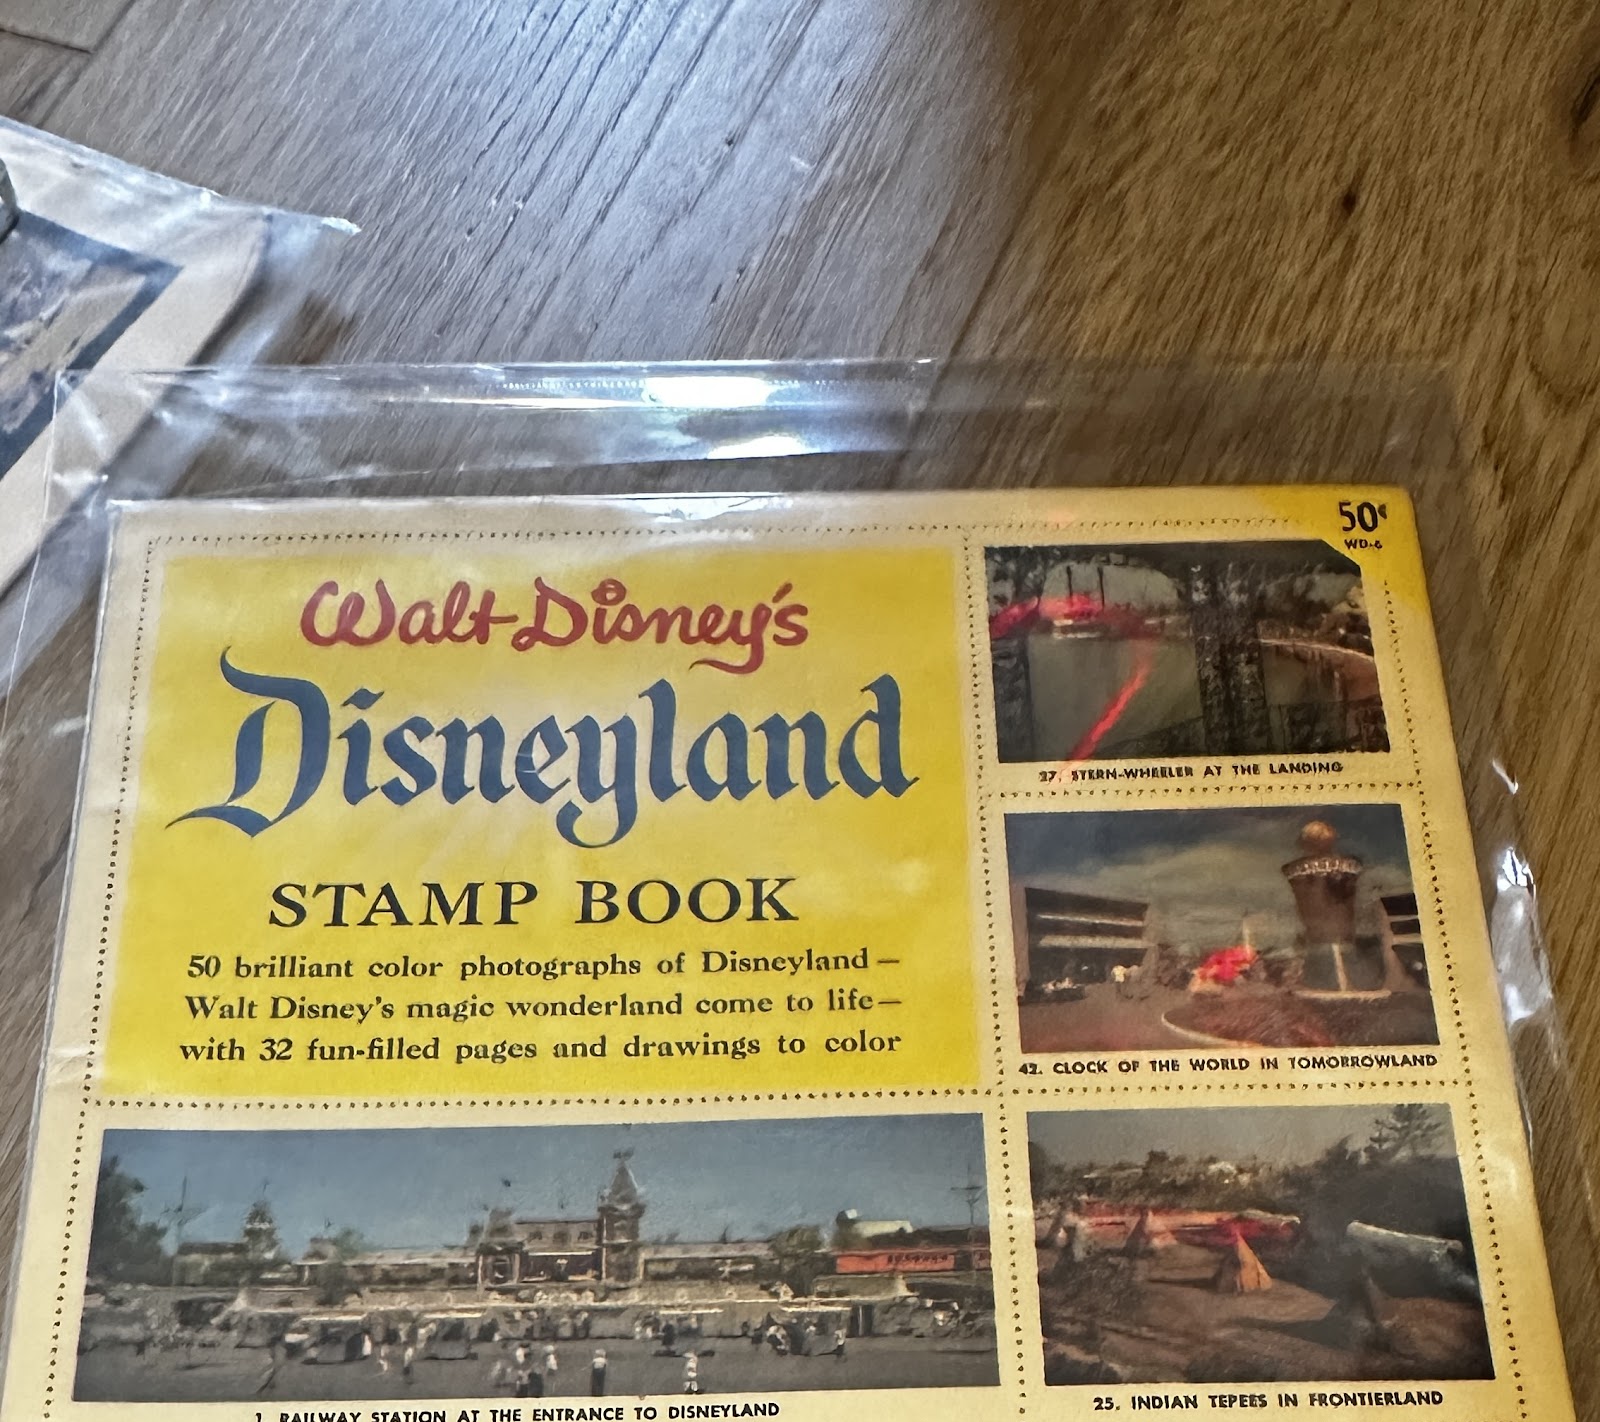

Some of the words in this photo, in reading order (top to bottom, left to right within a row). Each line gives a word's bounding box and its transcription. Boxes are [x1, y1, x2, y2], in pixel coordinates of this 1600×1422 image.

[301, 580, 518, 649] Walt
[167, 647, 918, 847] Disneyland
[1072, 766, 1193, 782] STERN-WHEELER
[1204, 765, 1222, 777] AT
[1232, 765, 1260, 776] THE
[1269, 762, 1344, 774] LANDING
[268, 881, 538, 928] STAMP
[576, 877, 800, 924] BOOK
[187, 954, 222, 980] 50
[234, 954, 354, 978] brilliant
[368, 954, 442, 977] color
[460, 951, 642, 981] photographs
[657, 950, 684, 974] of
[184, 995, 258, 1021] Walt
[407, 996, 495, 1025] magic
[505, 991, 683, 1017] wonderland
[695, 995, 772, 1016] come
[786, 992, 815, 1013] to
[180, 1038, 247, 1062] with
[259, 1038, 293, 1062] 32
[308, 1036, 440, 1061] fun-filled
[455, 1040, 538, 1064] pages
[552, 1033, 607, 1058] and
[622, 1033, 761, 1060] drawings
[778, 1031, 807, 1055] to
[825, 1029, 902, 1054] color
[1018, 1062, 1043, 1075] 42.
[1053, 1061, 1108, 1074] CLOCK
[1118, 1060, 1139, 1073] OF
[1149, 1059, 1180, 1072] THE
[1189, 1058, 1249, 1071] WORLD
[1261, 1057, 1278, 1070] IN
[1288, 1054, 1438, 1069] TOMORROWLAND
[457, 1408, 481, 1422] AT
[489, 1407, 522, 1422] THE
[532, 1406, 624, 1422] ENTRANCE
[635, 1405, 658, 1420] TO
[668, 1402, 780, 1419] DISNEYLAND
[1094, 1397, 1120, 1411] 25.
[1131, 1395, 1198, 1410] INDIAN
[1208, 1394, 1268, 1408] TEPEES
[1278, 1393, 1298, 1407] IN
[1309, 1390, 1444, 1407] FRONTIERLAND
